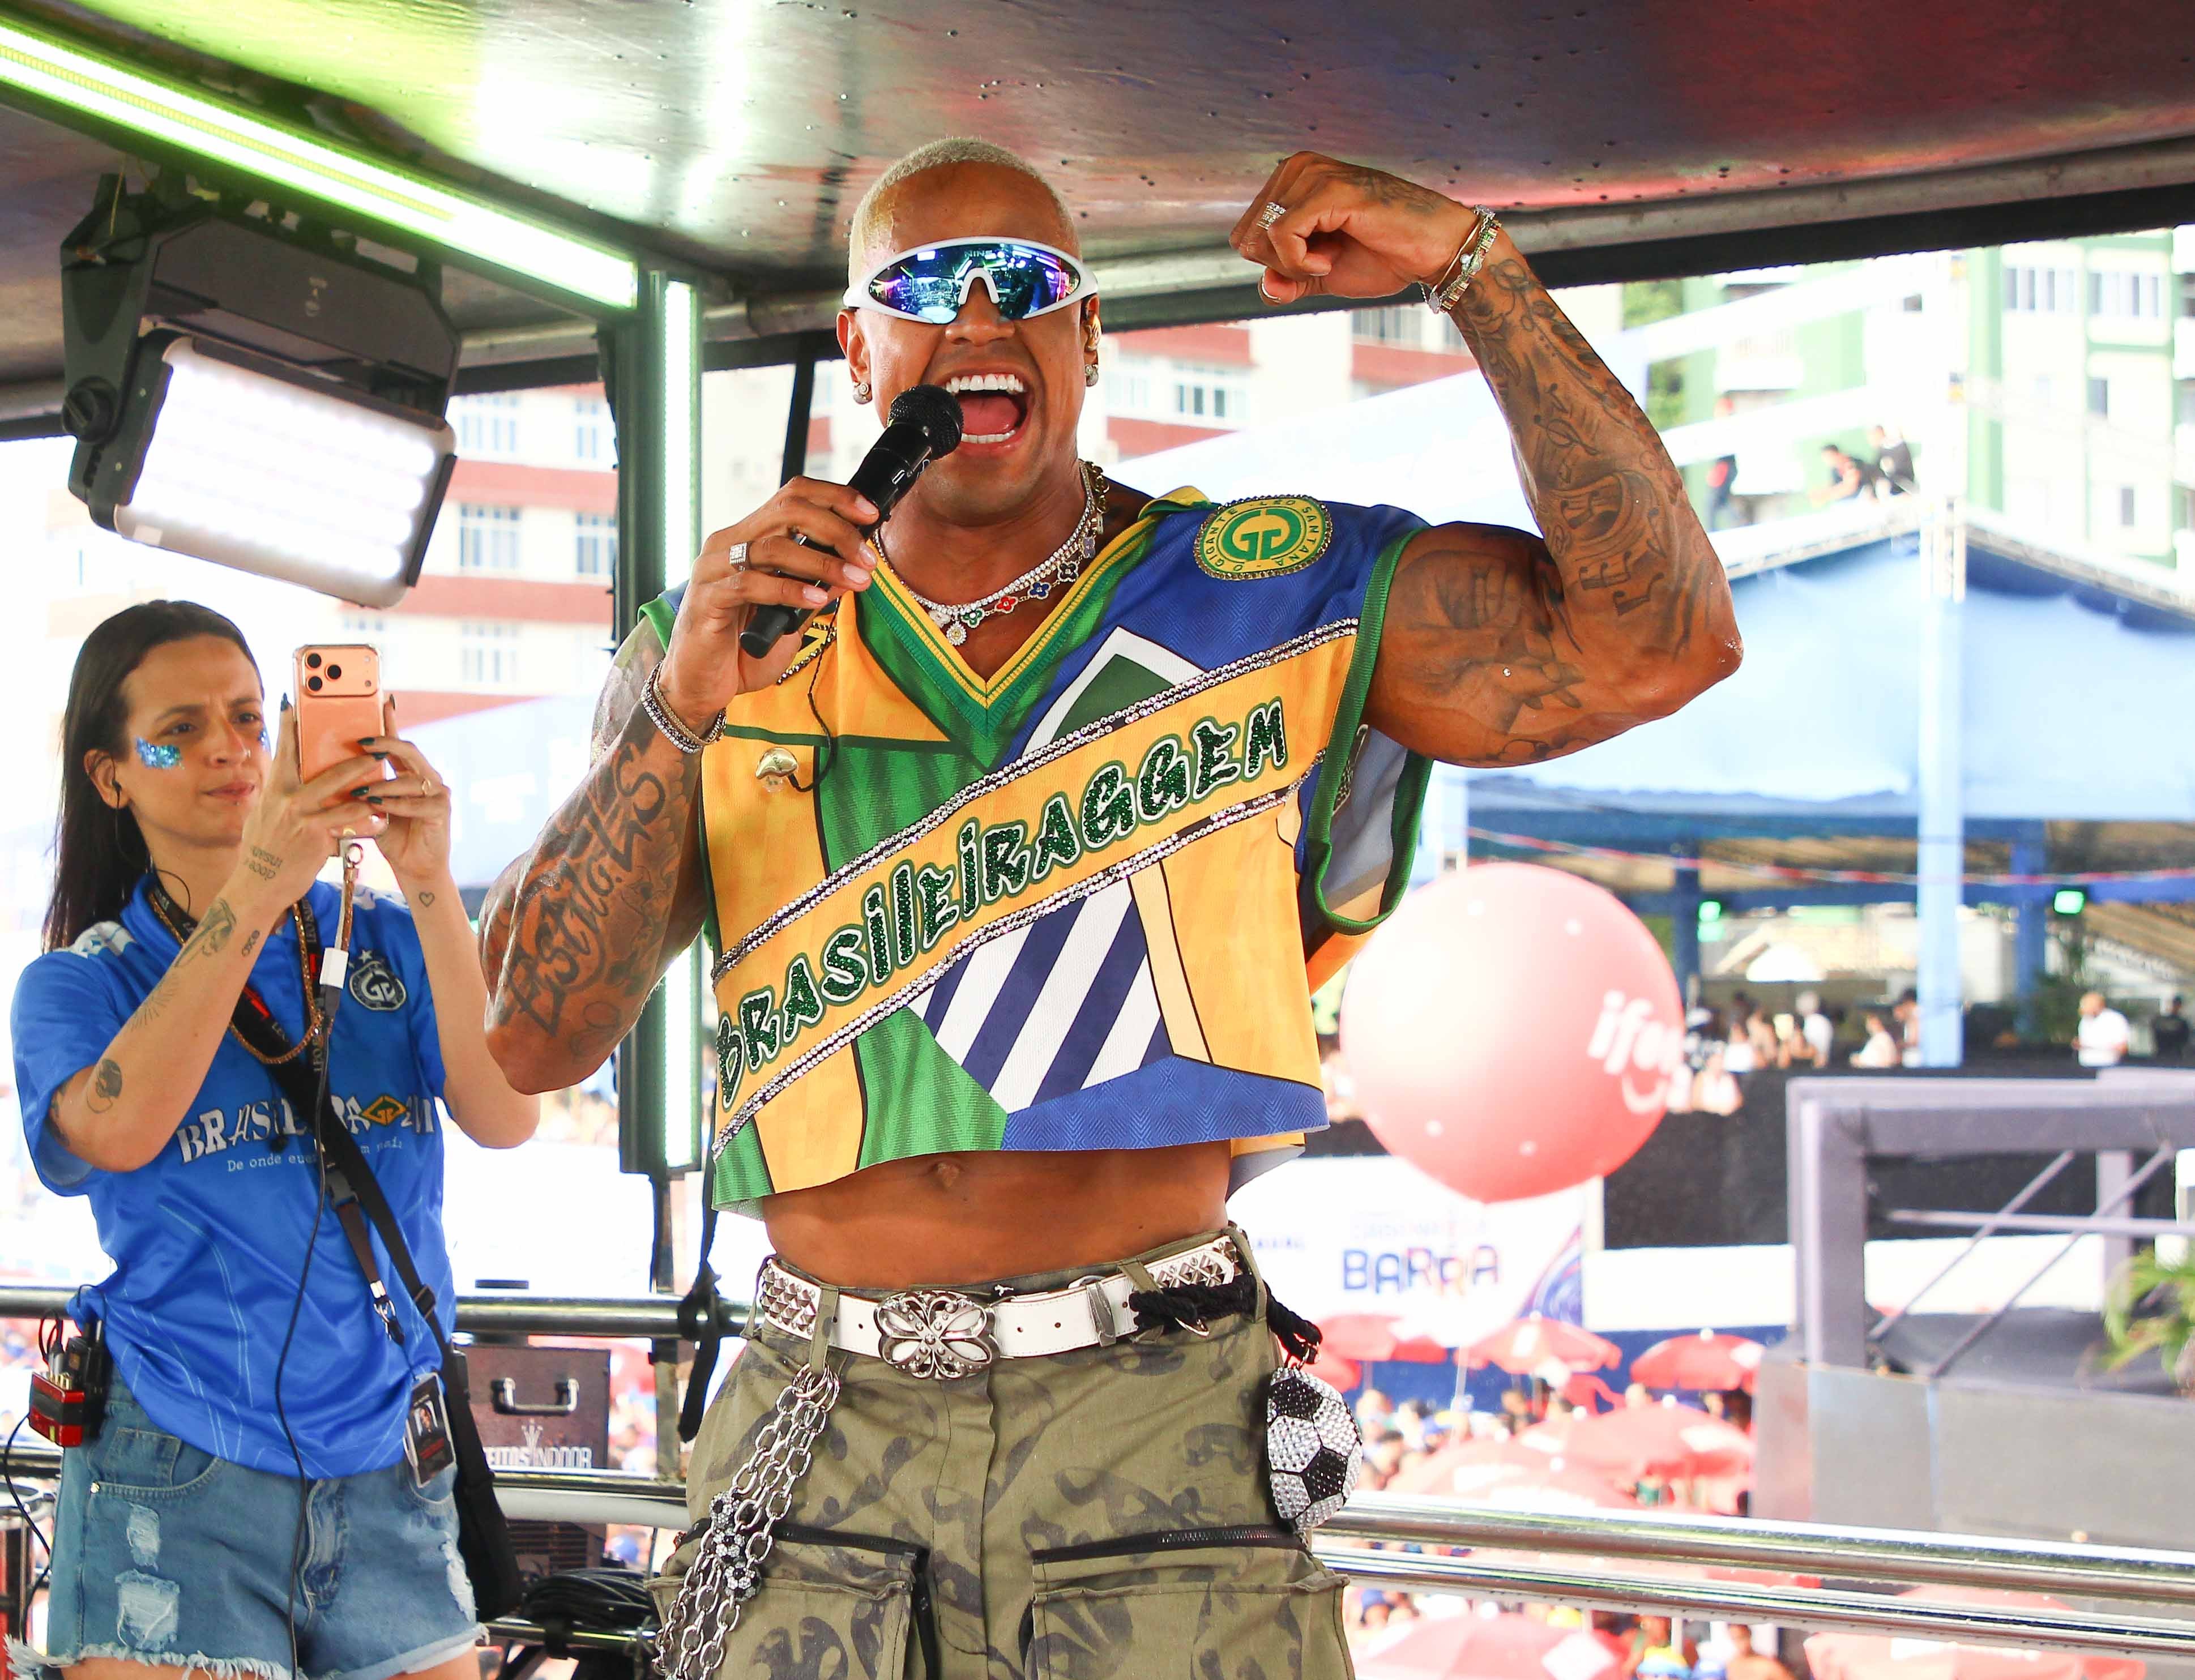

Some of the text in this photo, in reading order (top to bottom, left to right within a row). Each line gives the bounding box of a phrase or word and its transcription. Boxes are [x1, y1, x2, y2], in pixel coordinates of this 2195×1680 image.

[1206, 508, 1238, 567] GIGANTE
[1275, 506, 1318, 566] SANTANA
[227, 1159, 244, 1173] De
[249, 1153, 282, 1169] onde
[1343, 1245, 1500, 1296] BARRA
